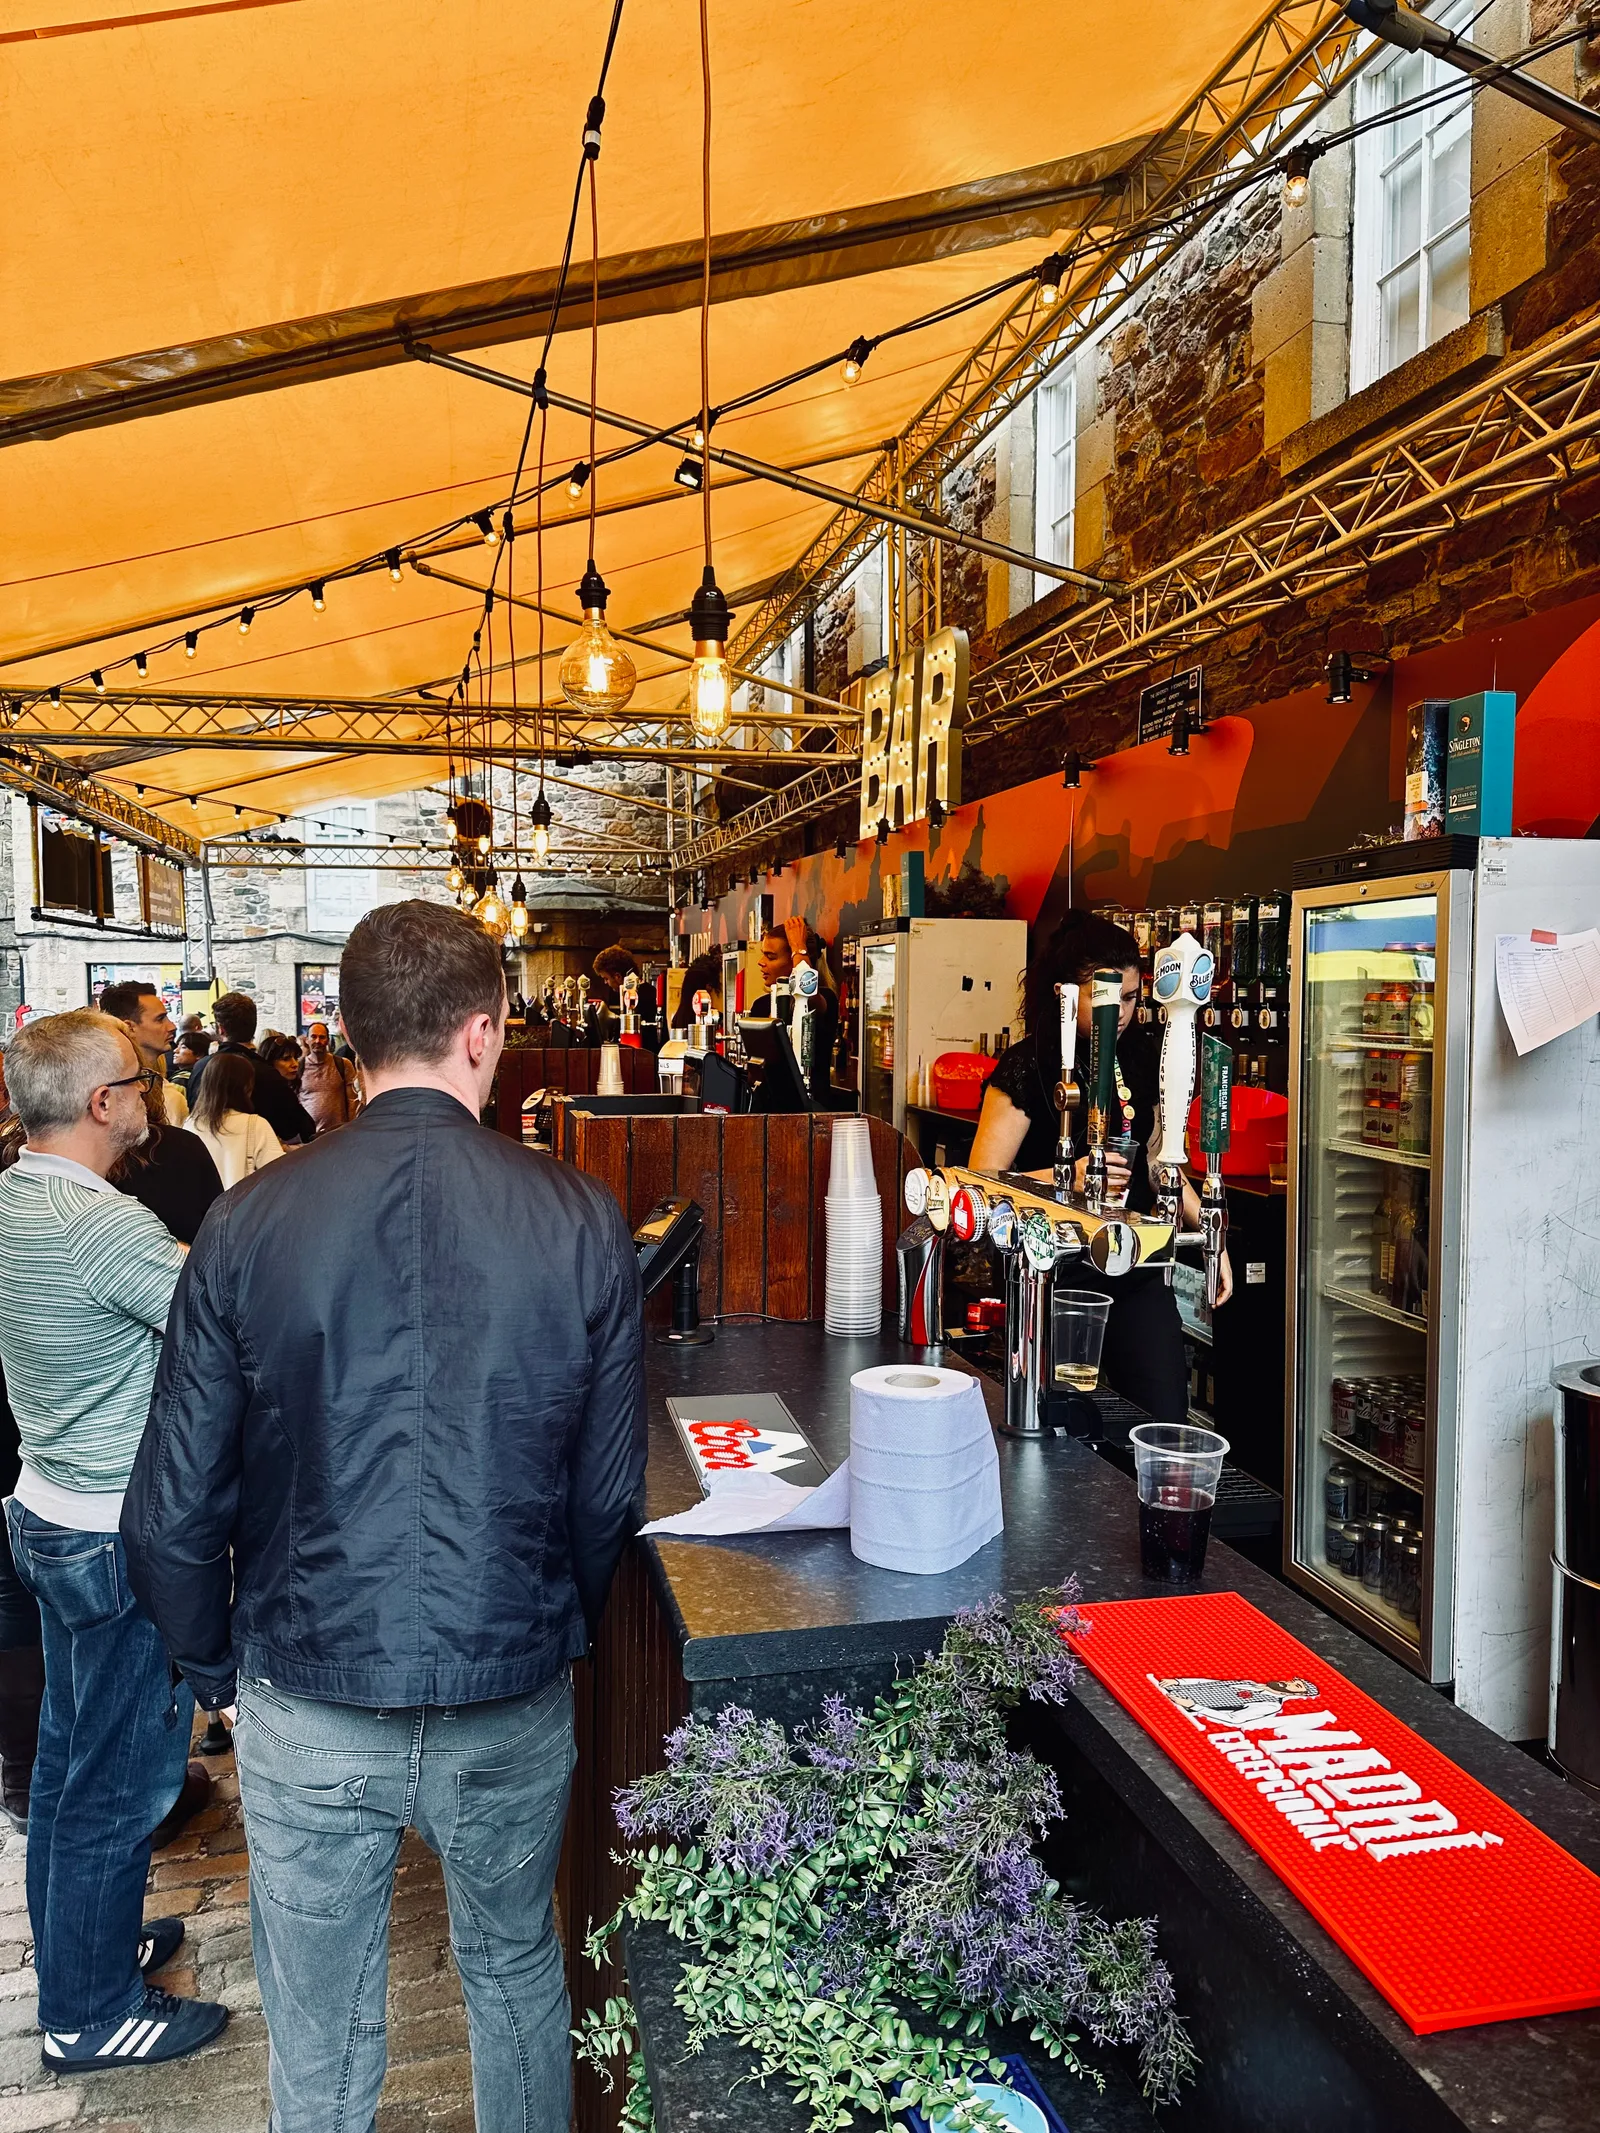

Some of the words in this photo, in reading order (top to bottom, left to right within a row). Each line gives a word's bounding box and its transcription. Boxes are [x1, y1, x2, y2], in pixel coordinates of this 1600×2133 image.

[859, 626, 970, 841] BAR
[1448, 736, 1481, 754] SINGLETON
[1448, 794, 1458, 807] 12
[1160, 962, 1182, 976] MOON
[1190, 970, 1210, 988] BLUE
[1160, 1021, 1172, 1083] BELGIAN
[1093, 1072, 1099, 1083] IN
[1221, 1065, 1229, 1110] FRANCISCAN
[1220, 1111, 1228, 1131] WELL
[688, 1418, 761, 1471] Coor
[1241, 1709, 1505, 1863] MADRÍ
